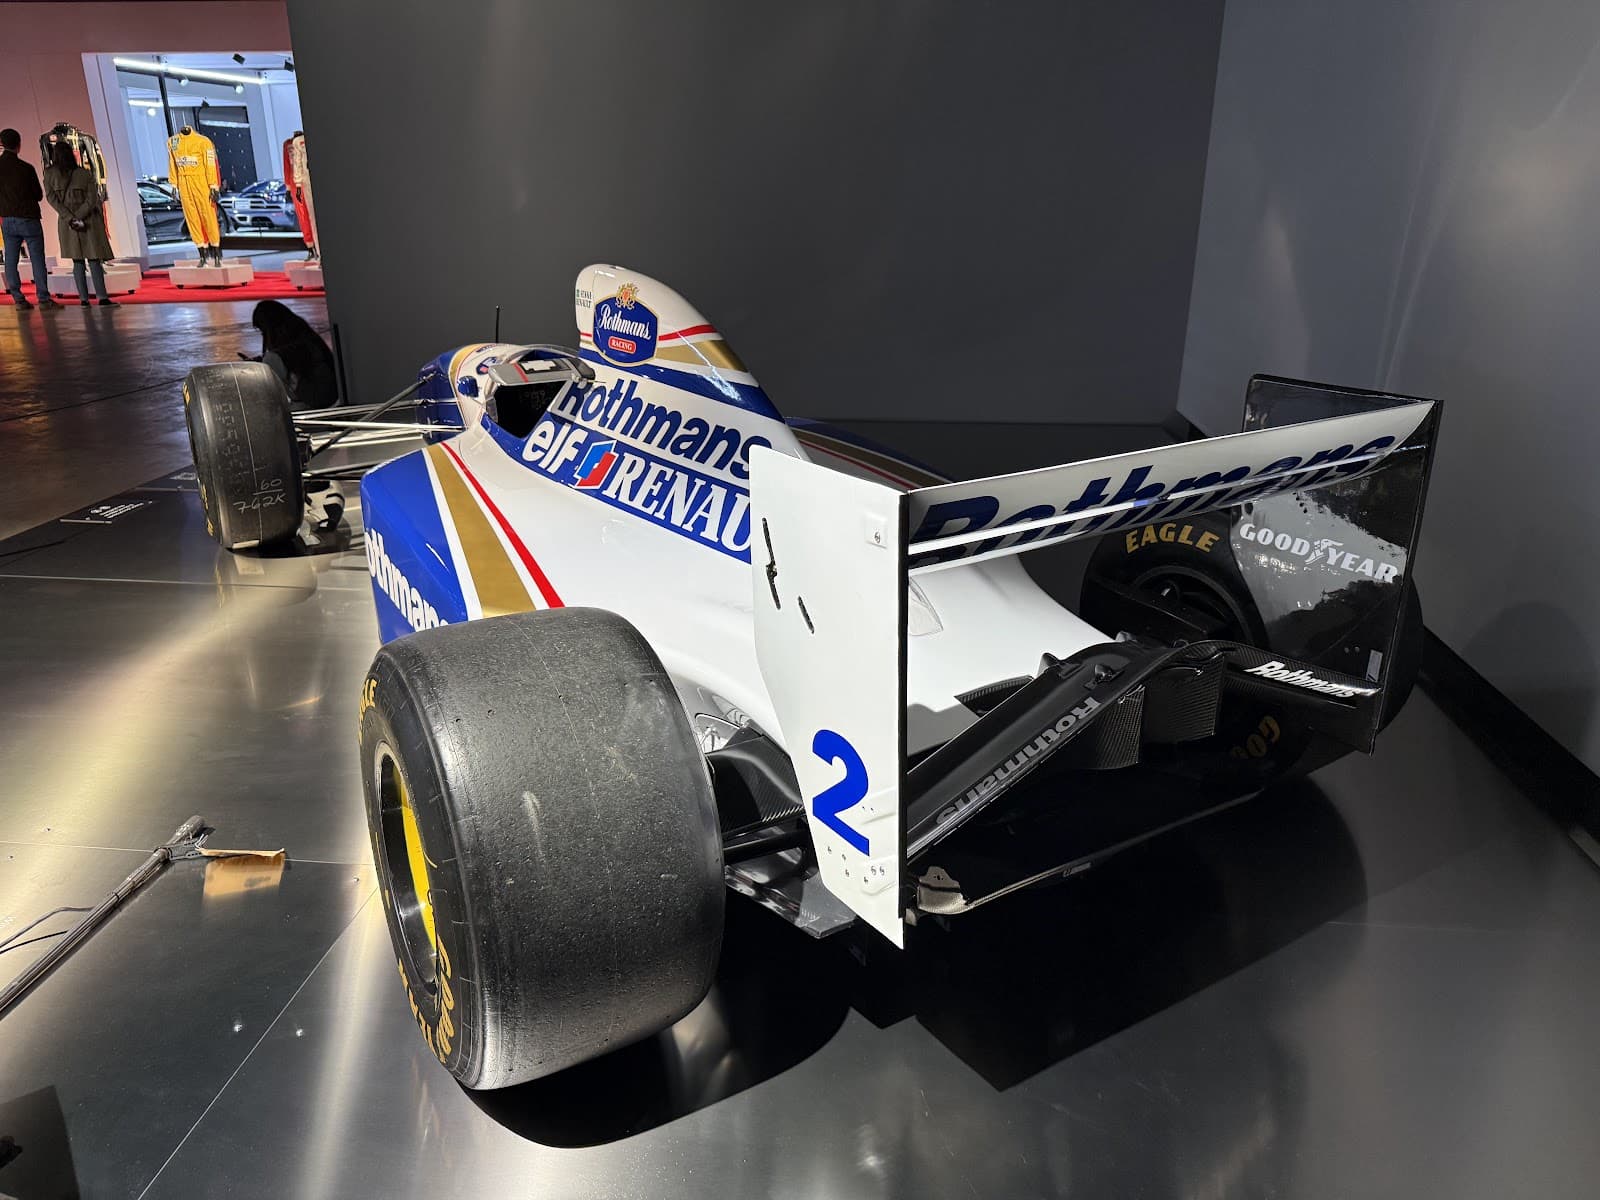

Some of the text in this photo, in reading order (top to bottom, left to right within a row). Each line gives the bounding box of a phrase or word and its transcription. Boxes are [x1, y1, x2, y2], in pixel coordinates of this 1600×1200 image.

[598, 303, 652, 340] Rothmans
[611, 339, 633, 351] RACING
[522, 420, 588, 474] elf
[260, 478, 283, 491] 60
[602, 451, 751, 552] RENAU
[1125, 522, 1221, 554] EAGLE
[1239, 523, 1398, 583] GOOD YEAR
[364, 527, 448, 633] othman
[1243, 660, 1355, 698] Rothmans
[936, 696, 1102, 826] Rothmans
[812, 729, 870, 856] 2
